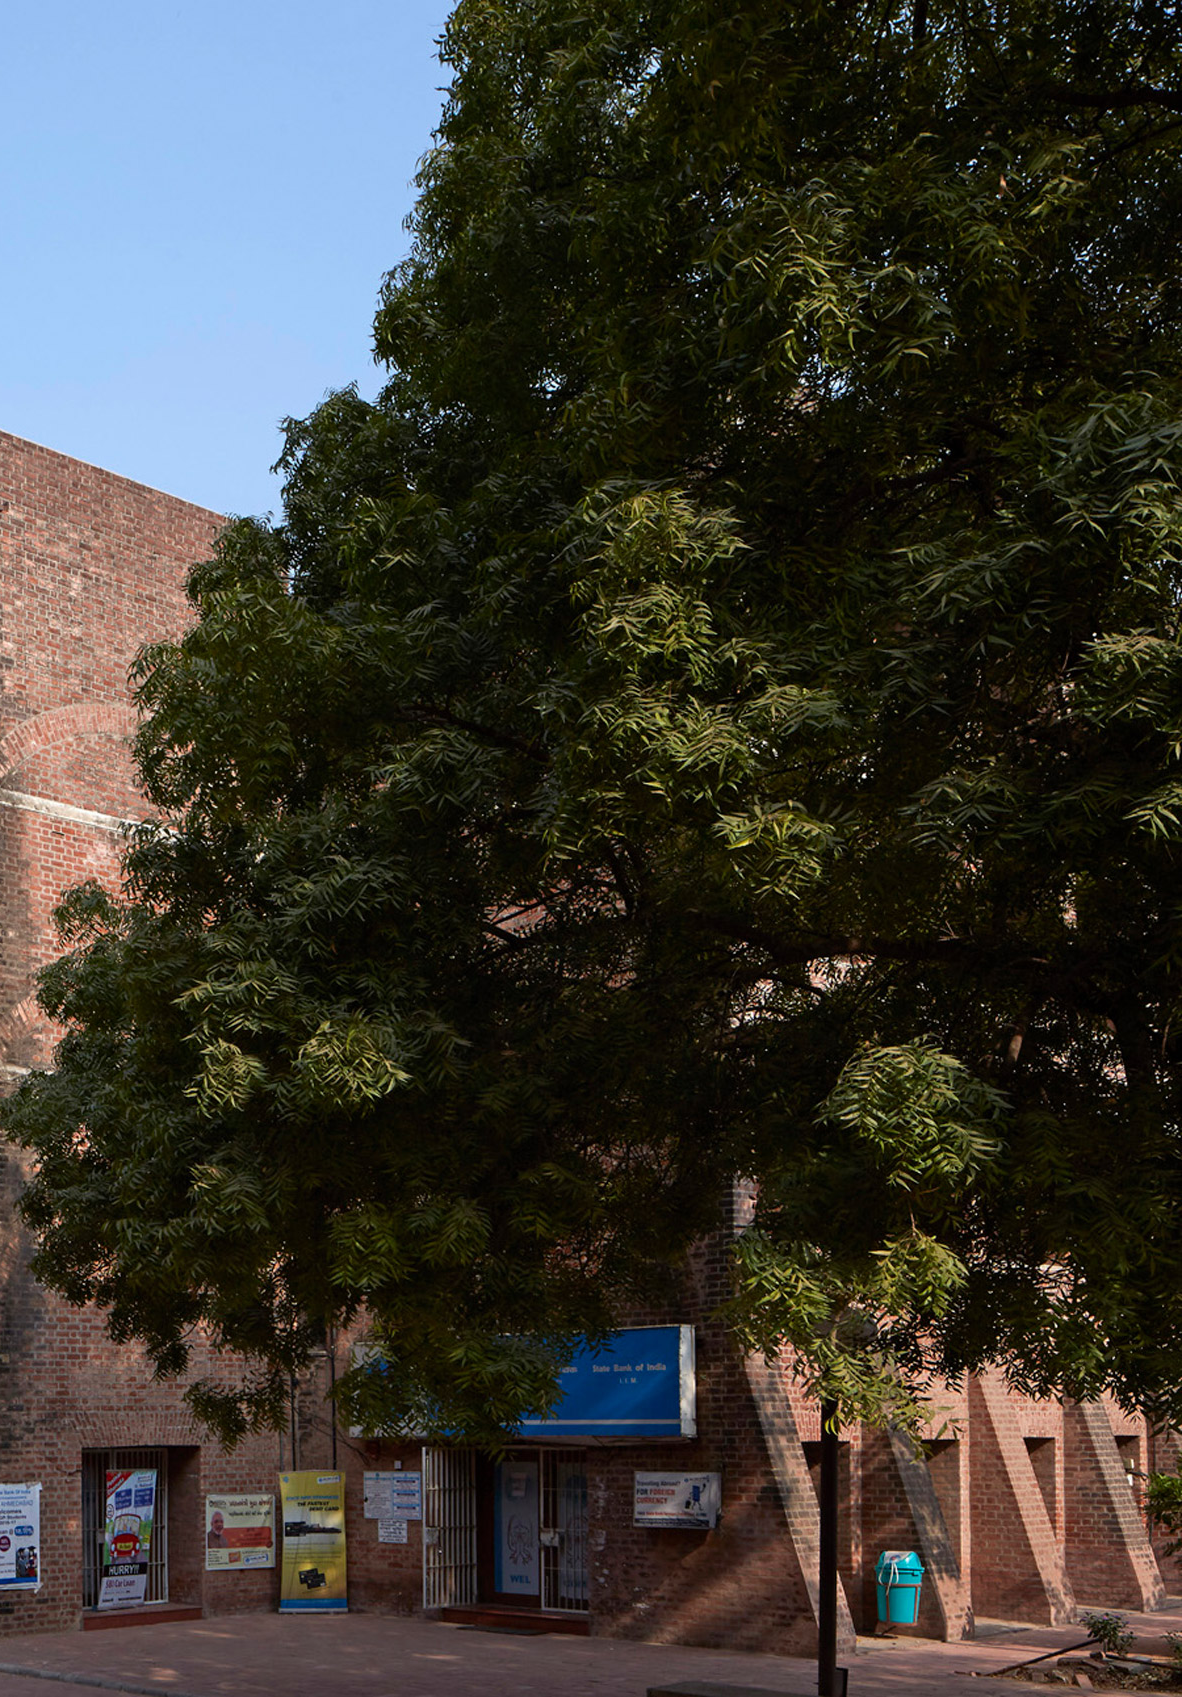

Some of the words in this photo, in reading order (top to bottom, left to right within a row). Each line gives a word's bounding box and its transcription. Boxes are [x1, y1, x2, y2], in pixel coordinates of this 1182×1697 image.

[592, 1364, 610, 1372] State
[613, 1363, 632, 1372] Bank
[635, 1363, 644, 1371] of
[647, 1363, 666, 1371] India
[510, 1575, 531, 1584] WEL
